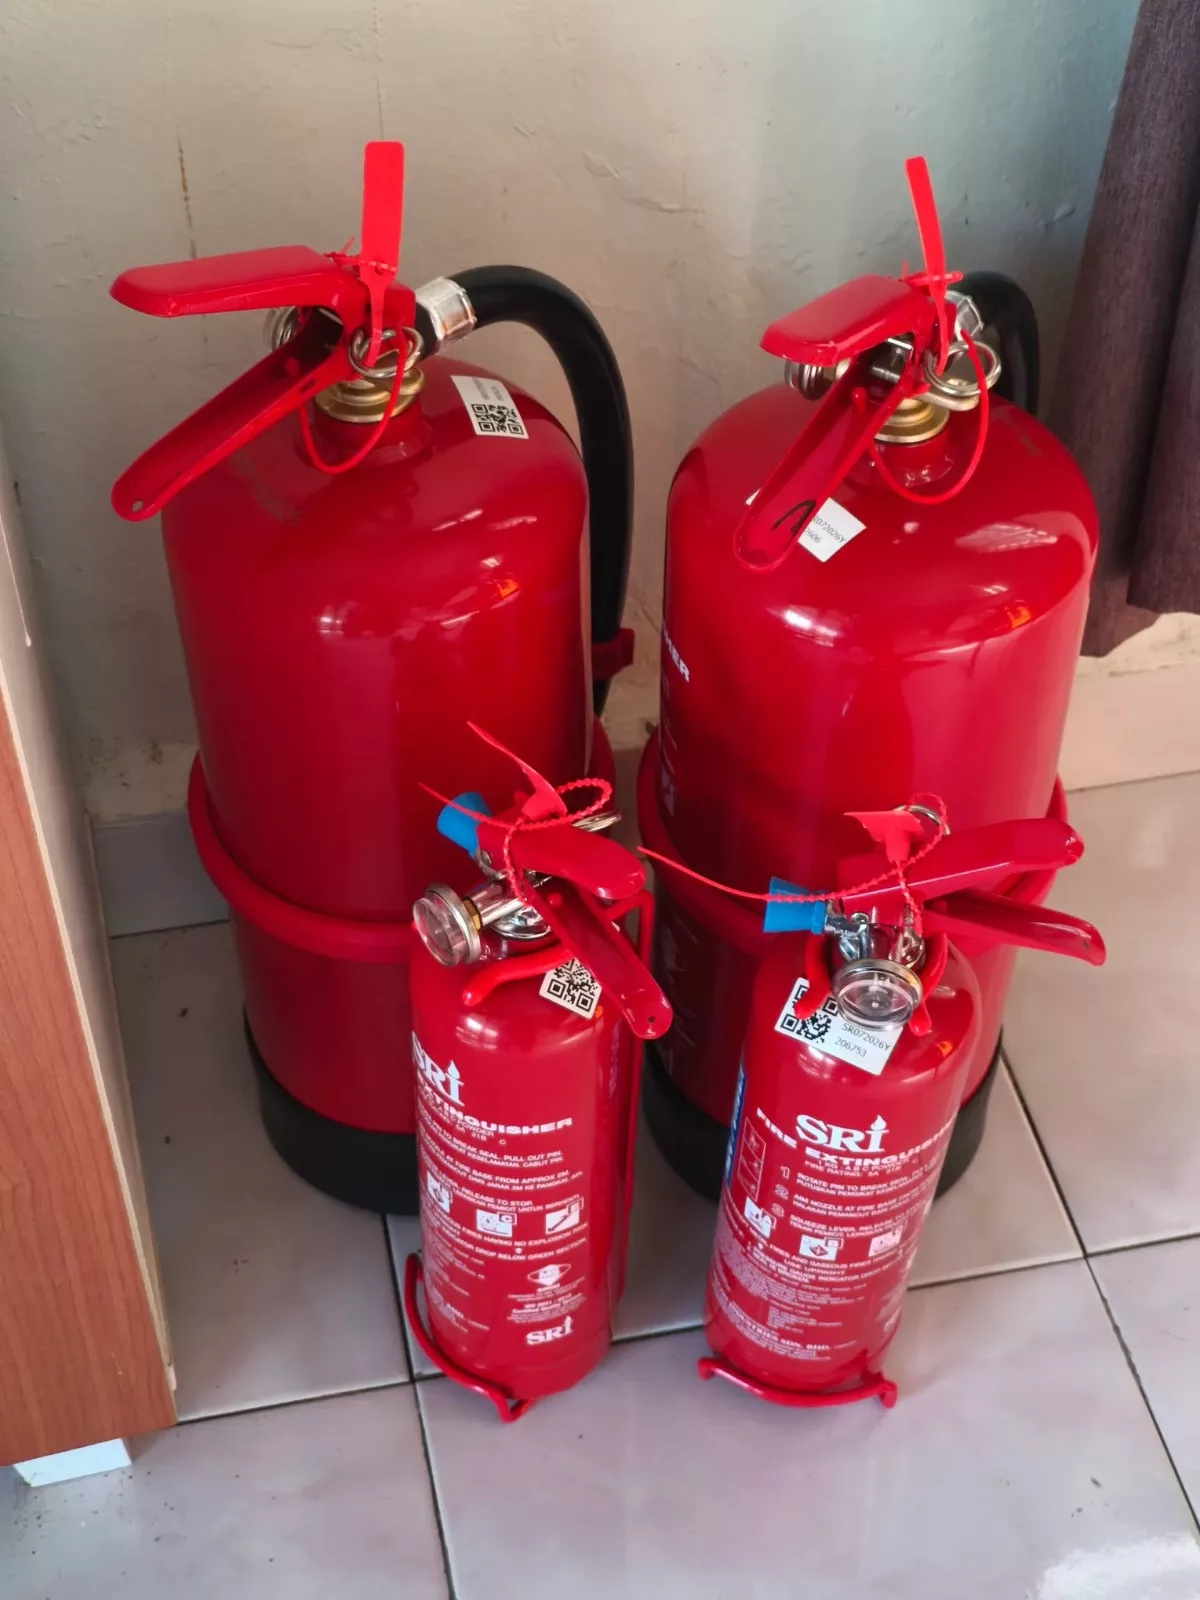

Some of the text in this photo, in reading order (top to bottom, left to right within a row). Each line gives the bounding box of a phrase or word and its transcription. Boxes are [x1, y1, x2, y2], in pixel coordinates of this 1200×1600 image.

[842, 1022, 891, 1051] SR072026Y
[834, 1036, 867, 1057] 206753
[503, 1154, 525, 1163] PULL
[527, 1152, 545, 1161] OUT
[494, 1174, 520, 1184] FROM
[521, 1174, 555, 1184] APPROX
[496, 1198, 508, 1206] TO
